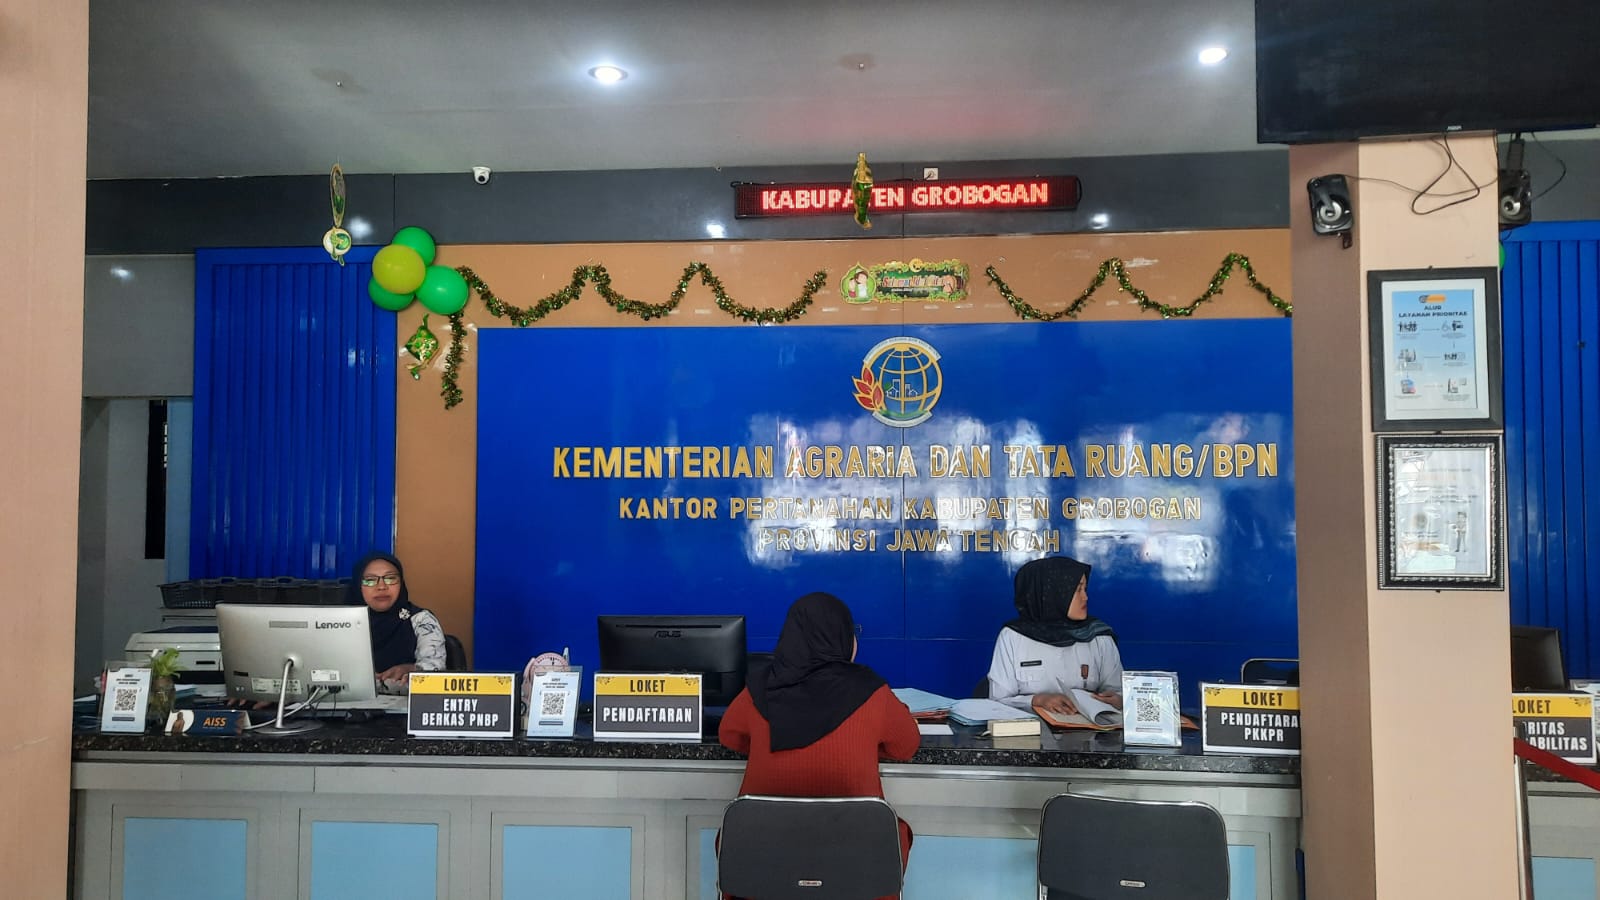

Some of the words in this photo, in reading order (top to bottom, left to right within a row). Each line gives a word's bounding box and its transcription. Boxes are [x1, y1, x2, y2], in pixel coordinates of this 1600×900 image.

[762, 187, 904, 209] KABUPAEN
[911, 183, 1048, 206] GROBOGAN
[553, 446, 774, 478] KEMENTERIAN
[784, 445, 917, 478] AGRARIA
[930, 444, 991, 478] DAN
[1003, 445, 1075, 478] TATA
[1085, 443, 1278, 478] RUANG/BPN
[619, 497, 718, 519] KANTOR
[730, 497, 892, 520] PERTANAHAN
[904, 497, 1049, 520] KABUPATEN
[1062, 497, 1201, 520] GROBOGAN
[759, 528, 876, 552] PROVINSI
[886, 529, 951, 552] JAWA
[960, 529, 1061, 552] TENGAH
[315, 620, 352, 629] Lenovo
[444, 678, 479, 691] LOKET
[630, 679, 666, 693] LOKET
[443, 698, 478, 712] ENTRY
[1243, 691, 1283, 706] LOKET
[422, 712, 465, 726] BERKAS
[469, 713, 499, 727] PNBP
[603, 707, 692, 722] PENDAFTARAN
[1244, 727, 1284, 742] PKKPR
[1522, 721, 1565, 735] RITAS
[1526, 736, 1587, 750] ABILITAS
